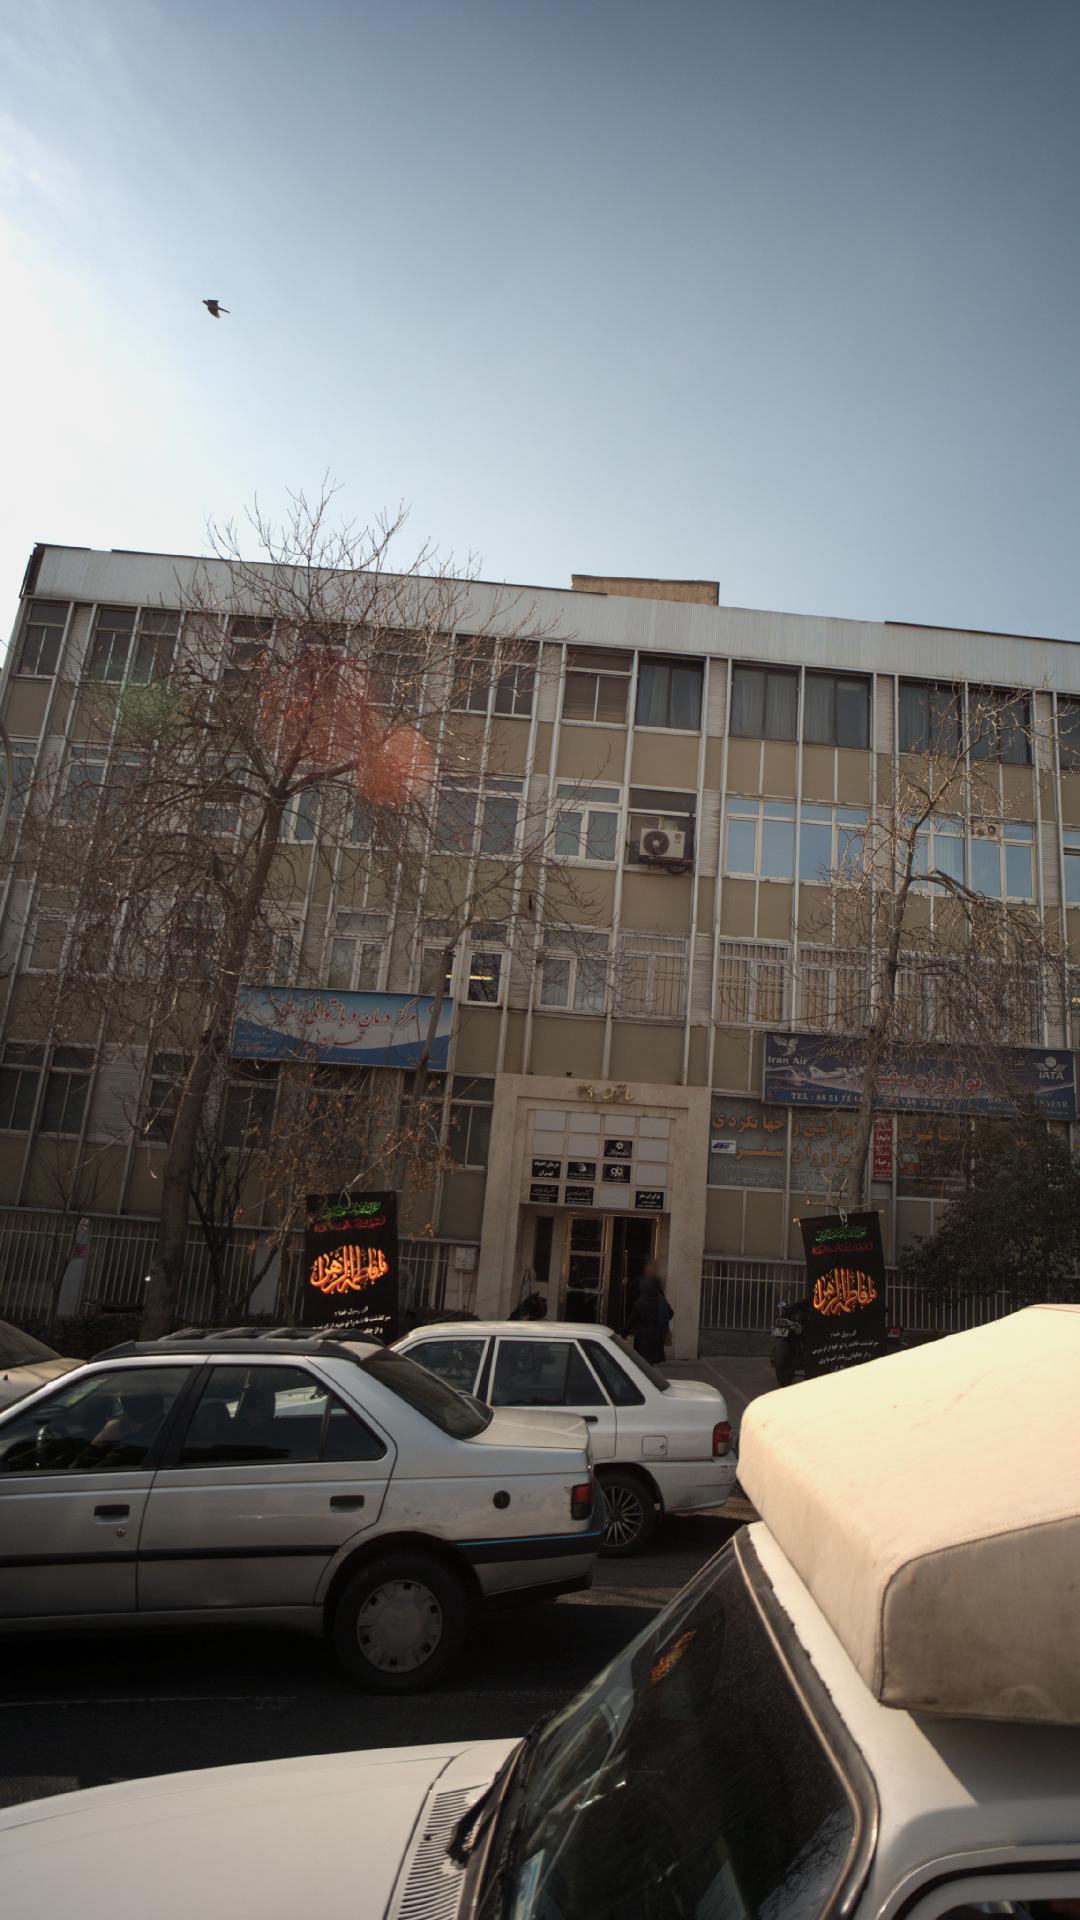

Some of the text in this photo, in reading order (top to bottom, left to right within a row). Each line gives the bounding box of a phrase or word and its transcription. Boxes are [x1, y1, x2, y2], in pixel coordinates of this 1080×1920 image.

[350, 1011, 359, 1024] و
[394, 996, 418, 1027] مرکز
[767, 1055, 809, 1066] Iran Air
[1038, 1071, 1064, 1081] IATA
[735, 1144, 785, 1161] سفر
